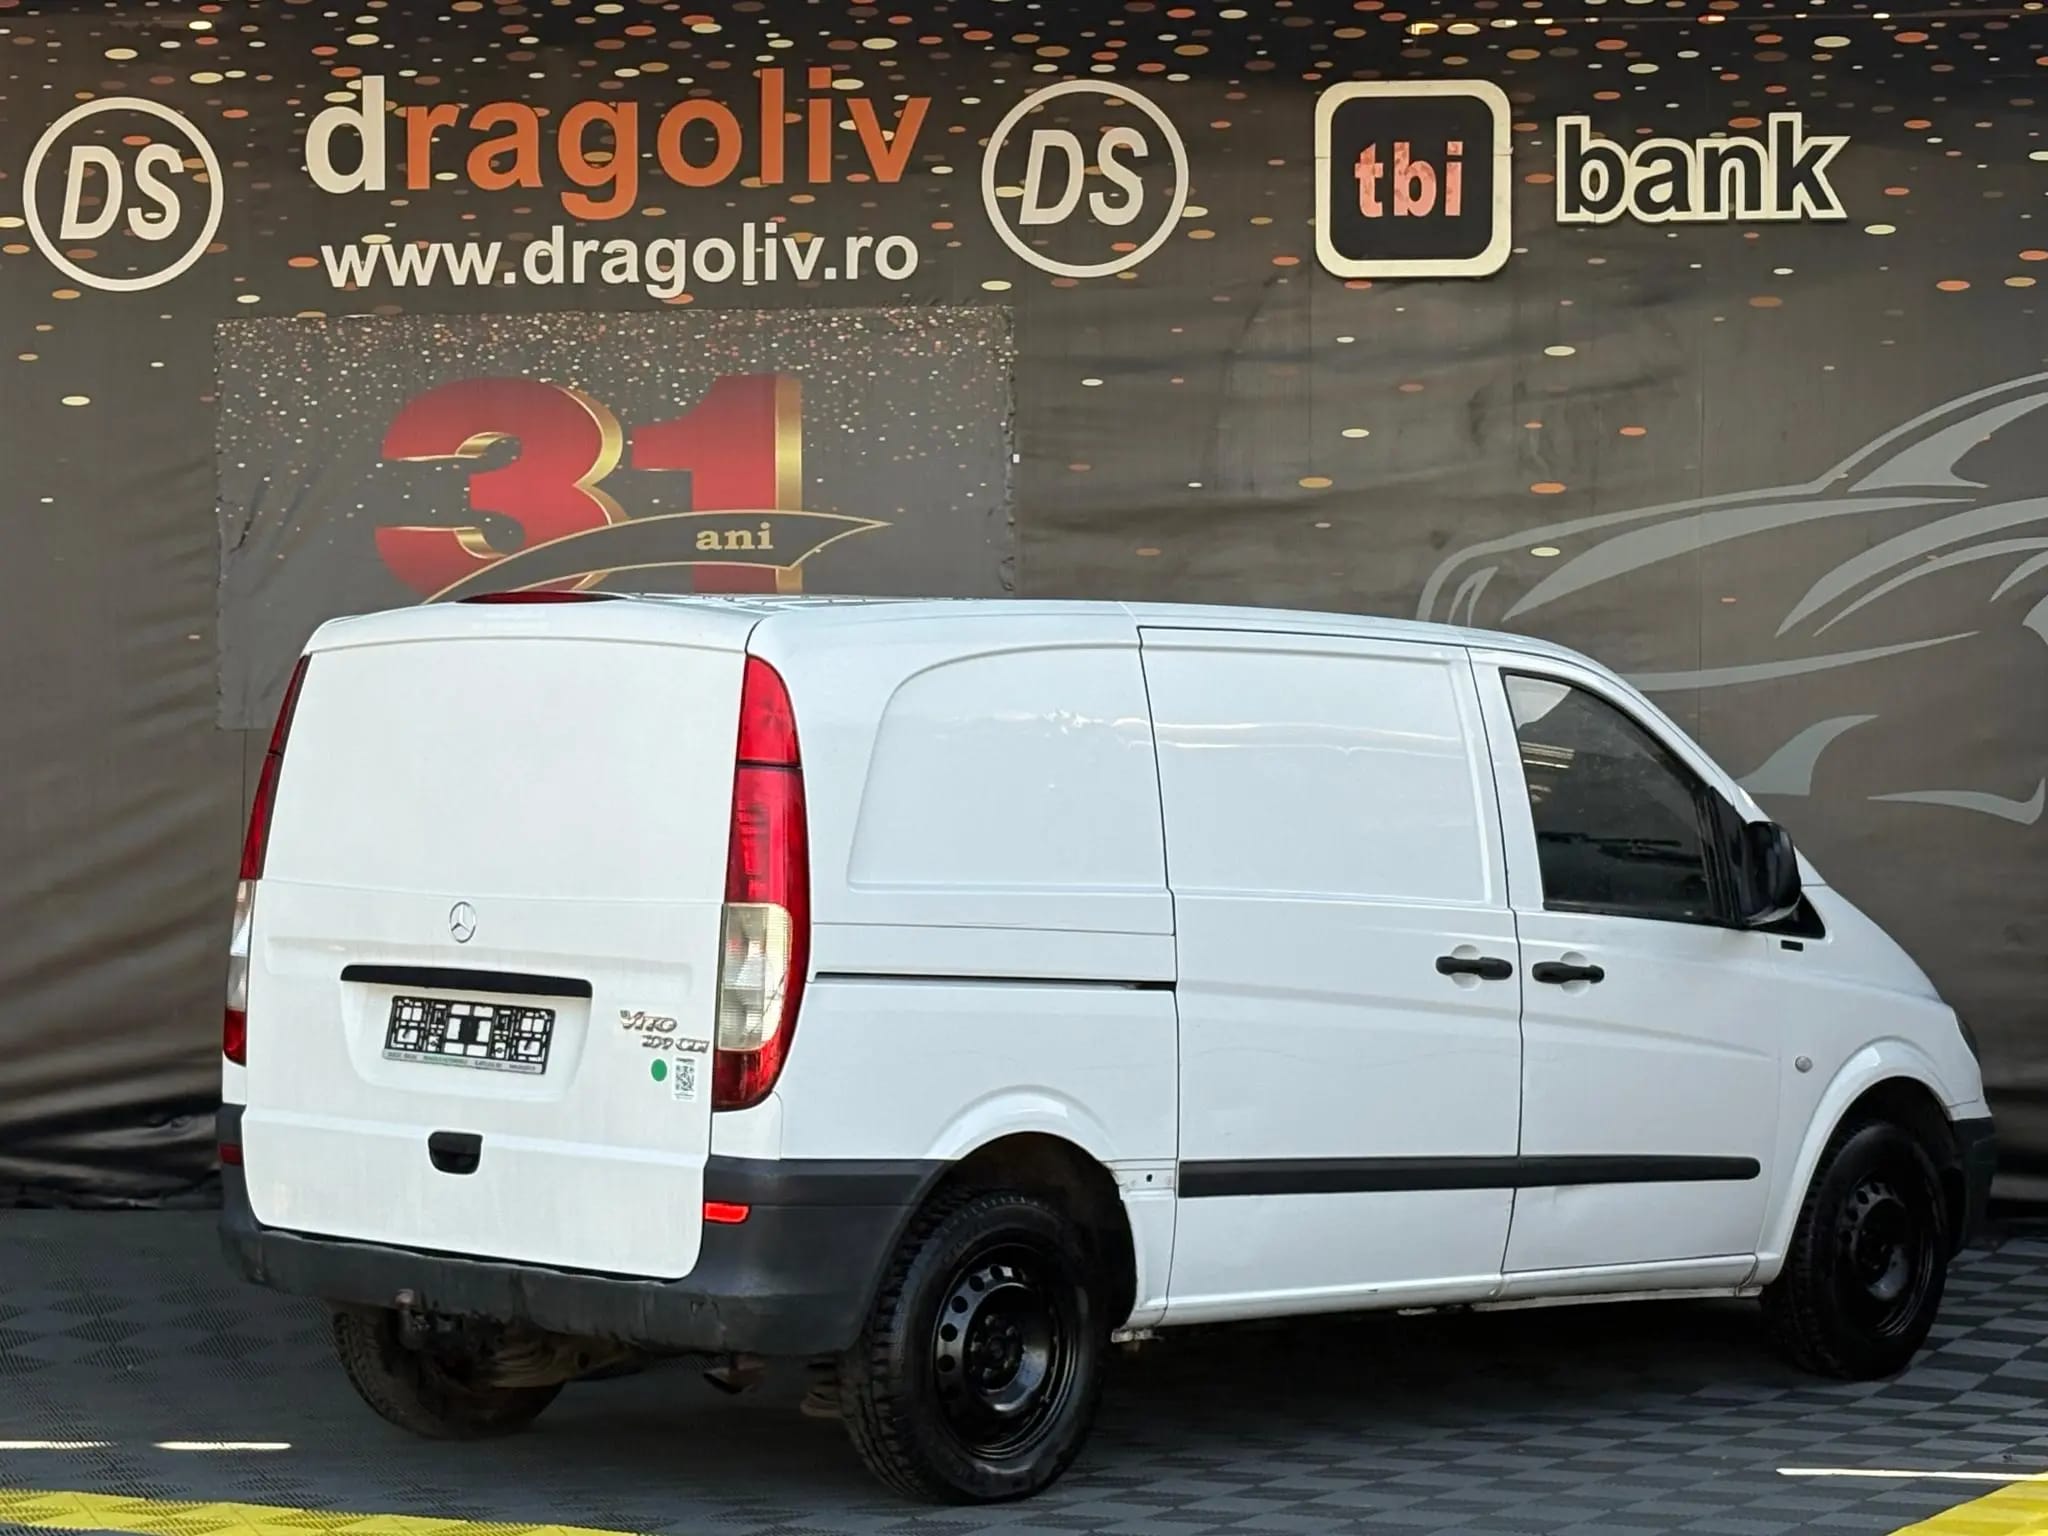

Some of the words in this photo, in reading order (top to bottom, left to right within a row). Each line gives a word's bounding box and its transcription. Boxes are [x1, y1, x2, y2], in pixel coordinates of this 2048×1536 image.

[60, 143, 185, 241] DS
[305, 67, 932, 220] dragoliv
[1018, 126, 1149, 226] DS
[1354, 141, 1464, 218] tbi
[1555, 111, 1851, 224] bank
[320, 222, 919, 300] www.dragoliv.ro
[373, 372, 804, 596] 31
[695, 521, 774, 551] ani
